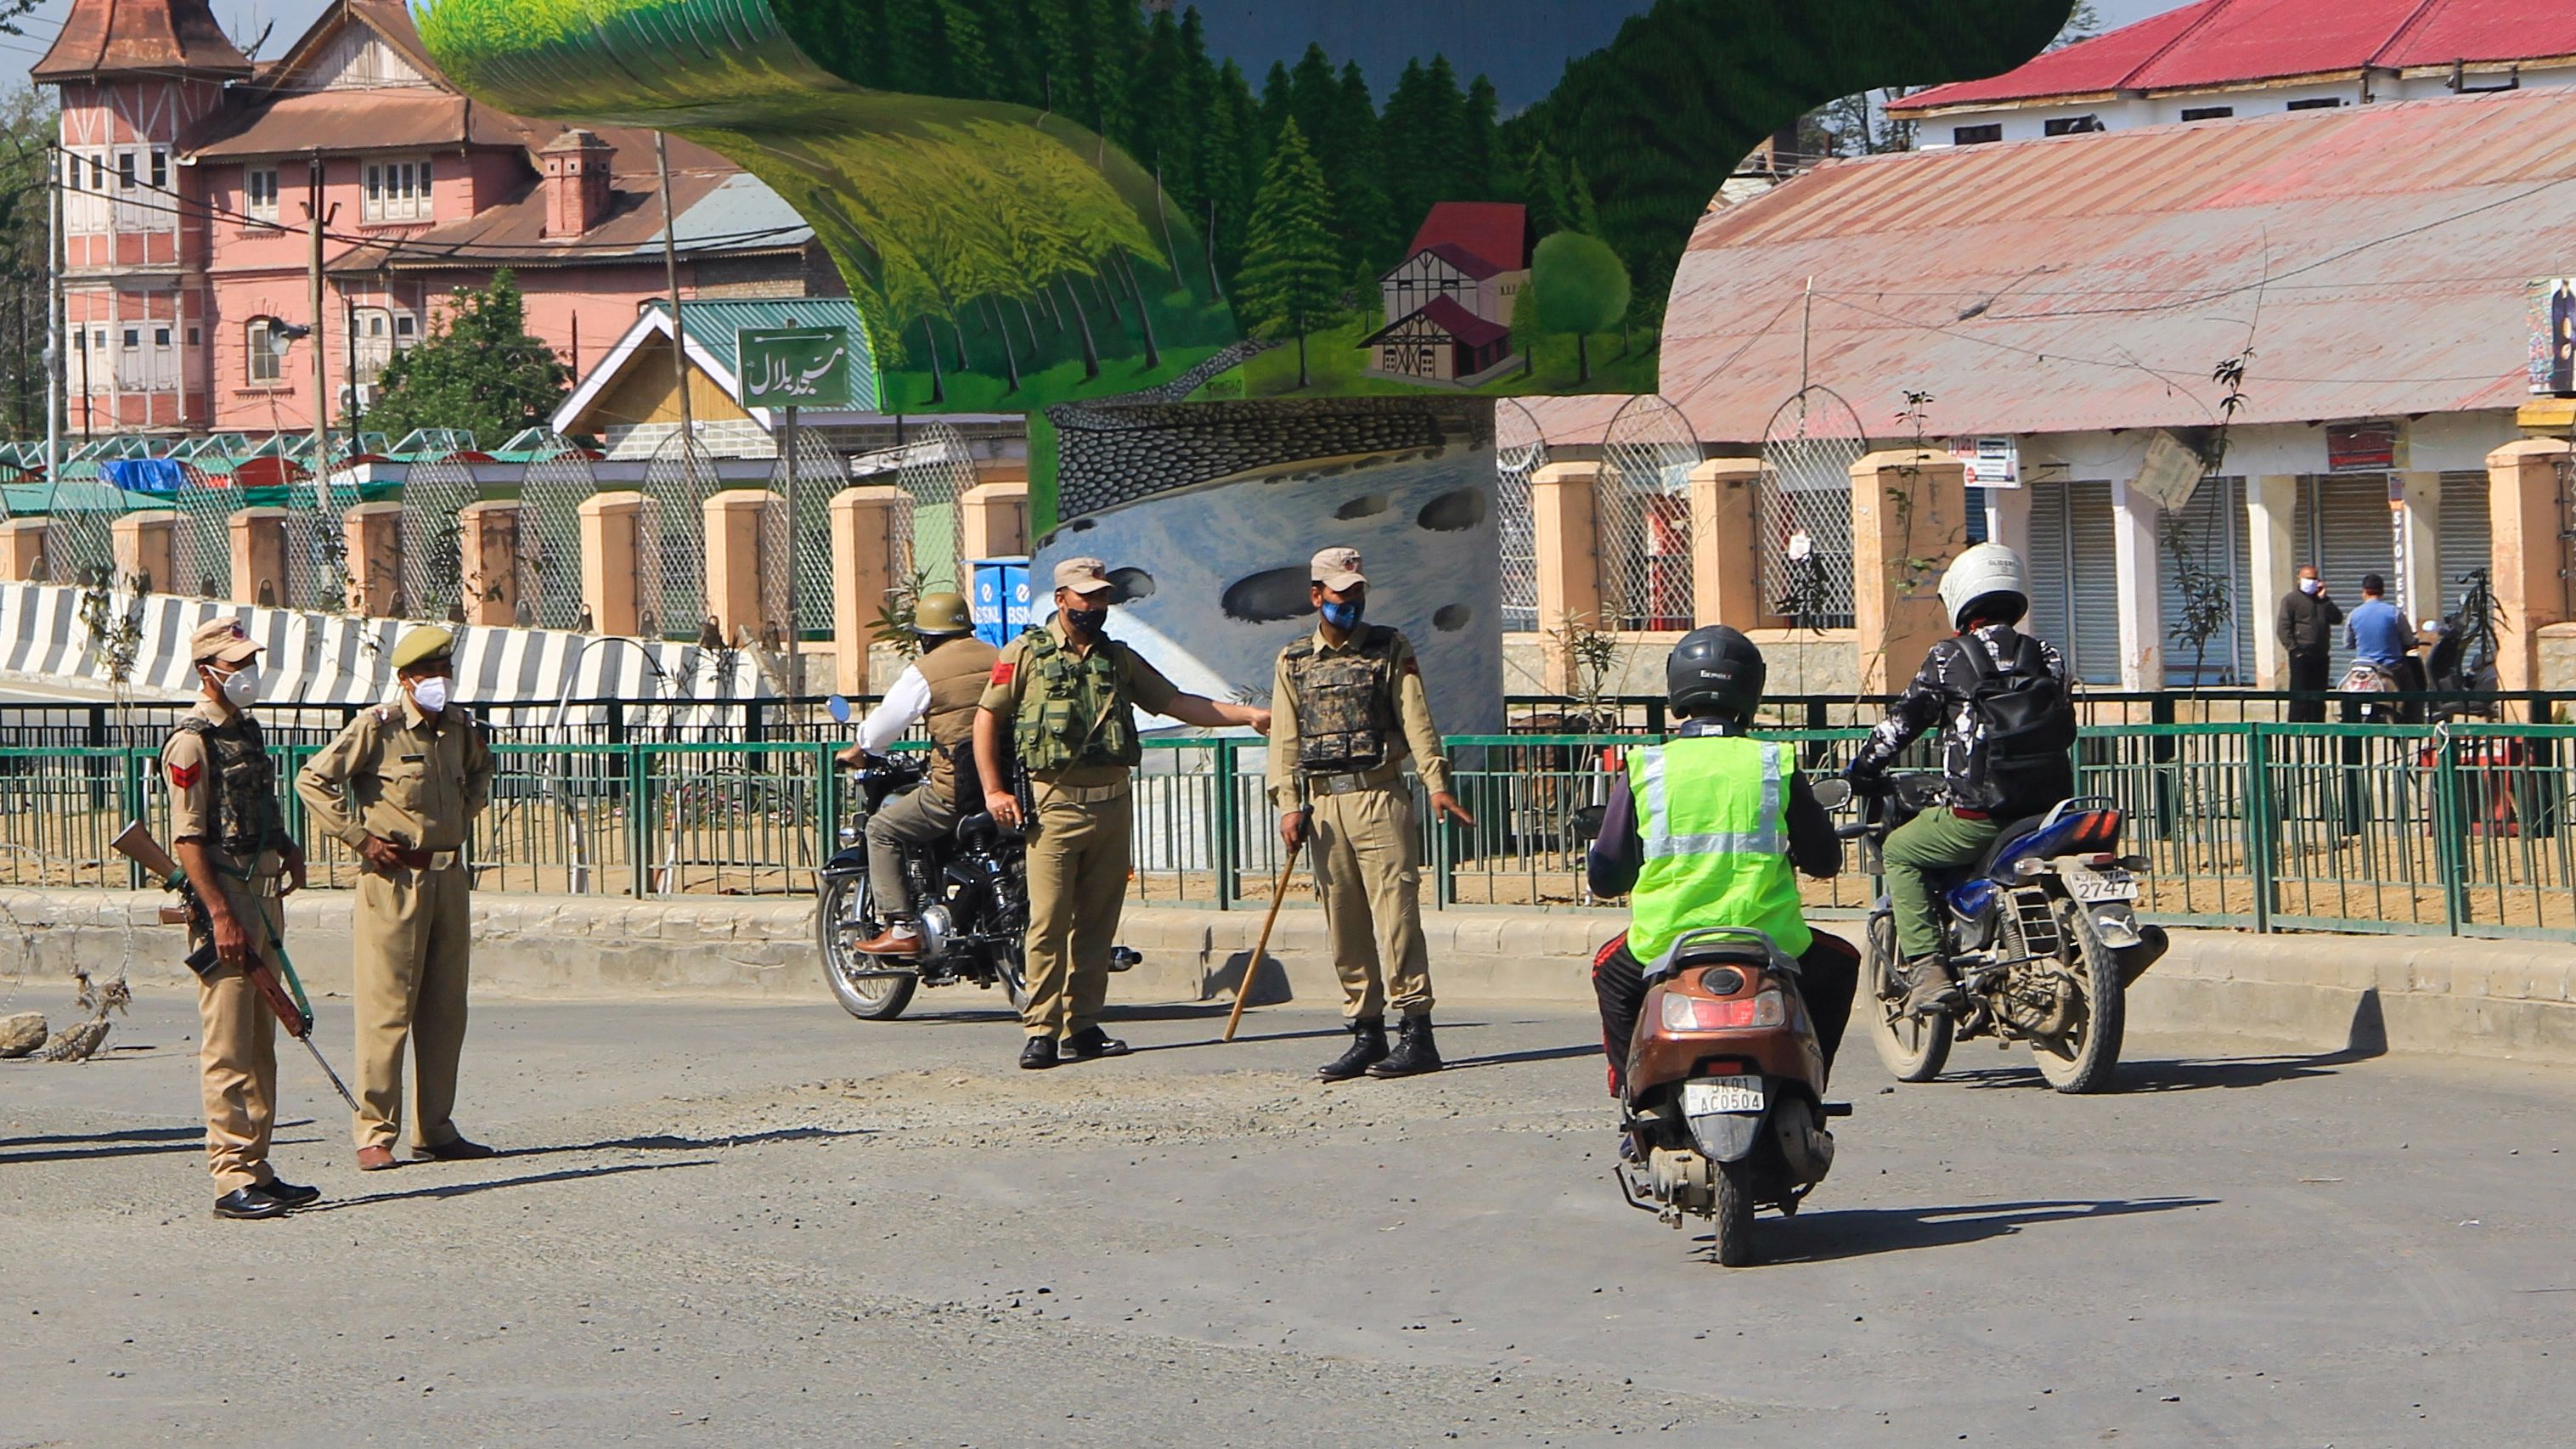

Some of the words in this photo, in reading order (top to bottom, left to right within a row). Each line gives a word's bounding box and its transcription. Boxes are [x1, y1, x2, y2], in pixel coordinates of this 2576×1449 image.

[2393, 510, 2405, 609] STONES
[1007, 606, 1031, 625] BSN
[2078, 880, 2130, 899] 2747
[1701, 1095, 1760, 1113] AC0504
